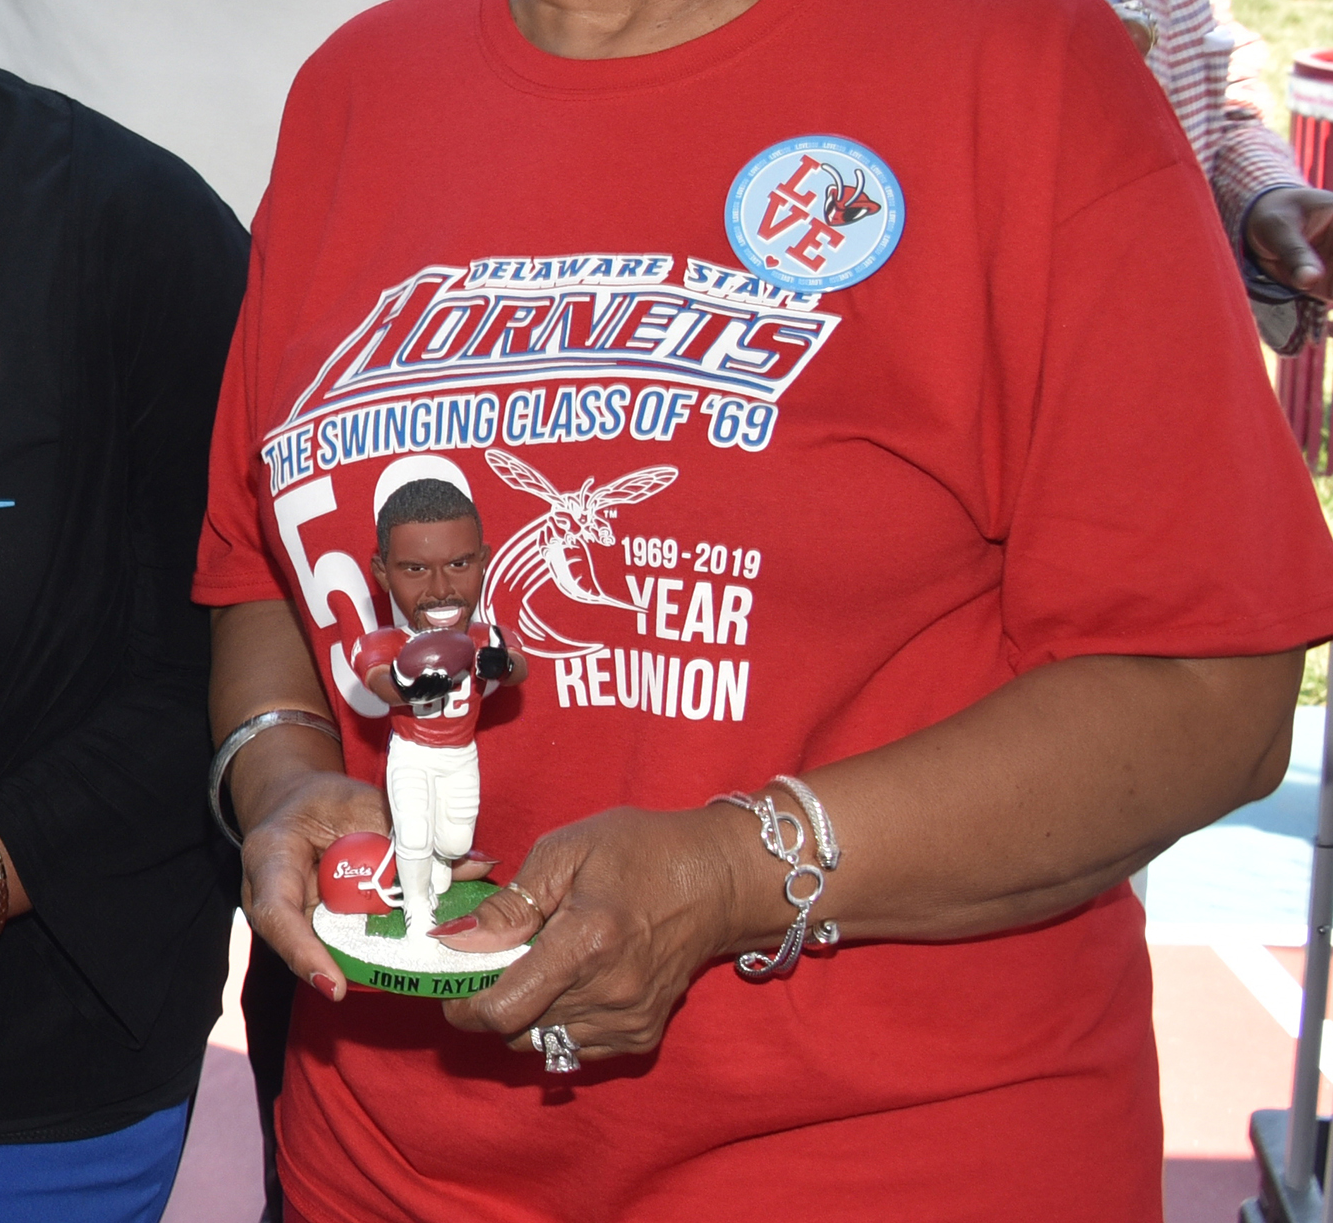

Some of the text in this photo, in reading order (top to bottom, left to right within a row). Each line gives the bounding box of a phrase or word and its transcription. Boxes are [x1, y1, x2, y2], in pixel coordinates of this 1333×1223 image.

[466, 255, 674, 287] DELAWARE
[308, 265, 841, 402] HORNETS
[262, 422, 315, 497] THE
[317, 391, 499, 469] SWINGING
[504, 383, 631, 446] CLASS
[630, 386, 699, 442] OF
[625, 575, 753, 645] YEAR
[554, 648, 750, 721] REUNION
[369, 969, 419, 993] JOHN
